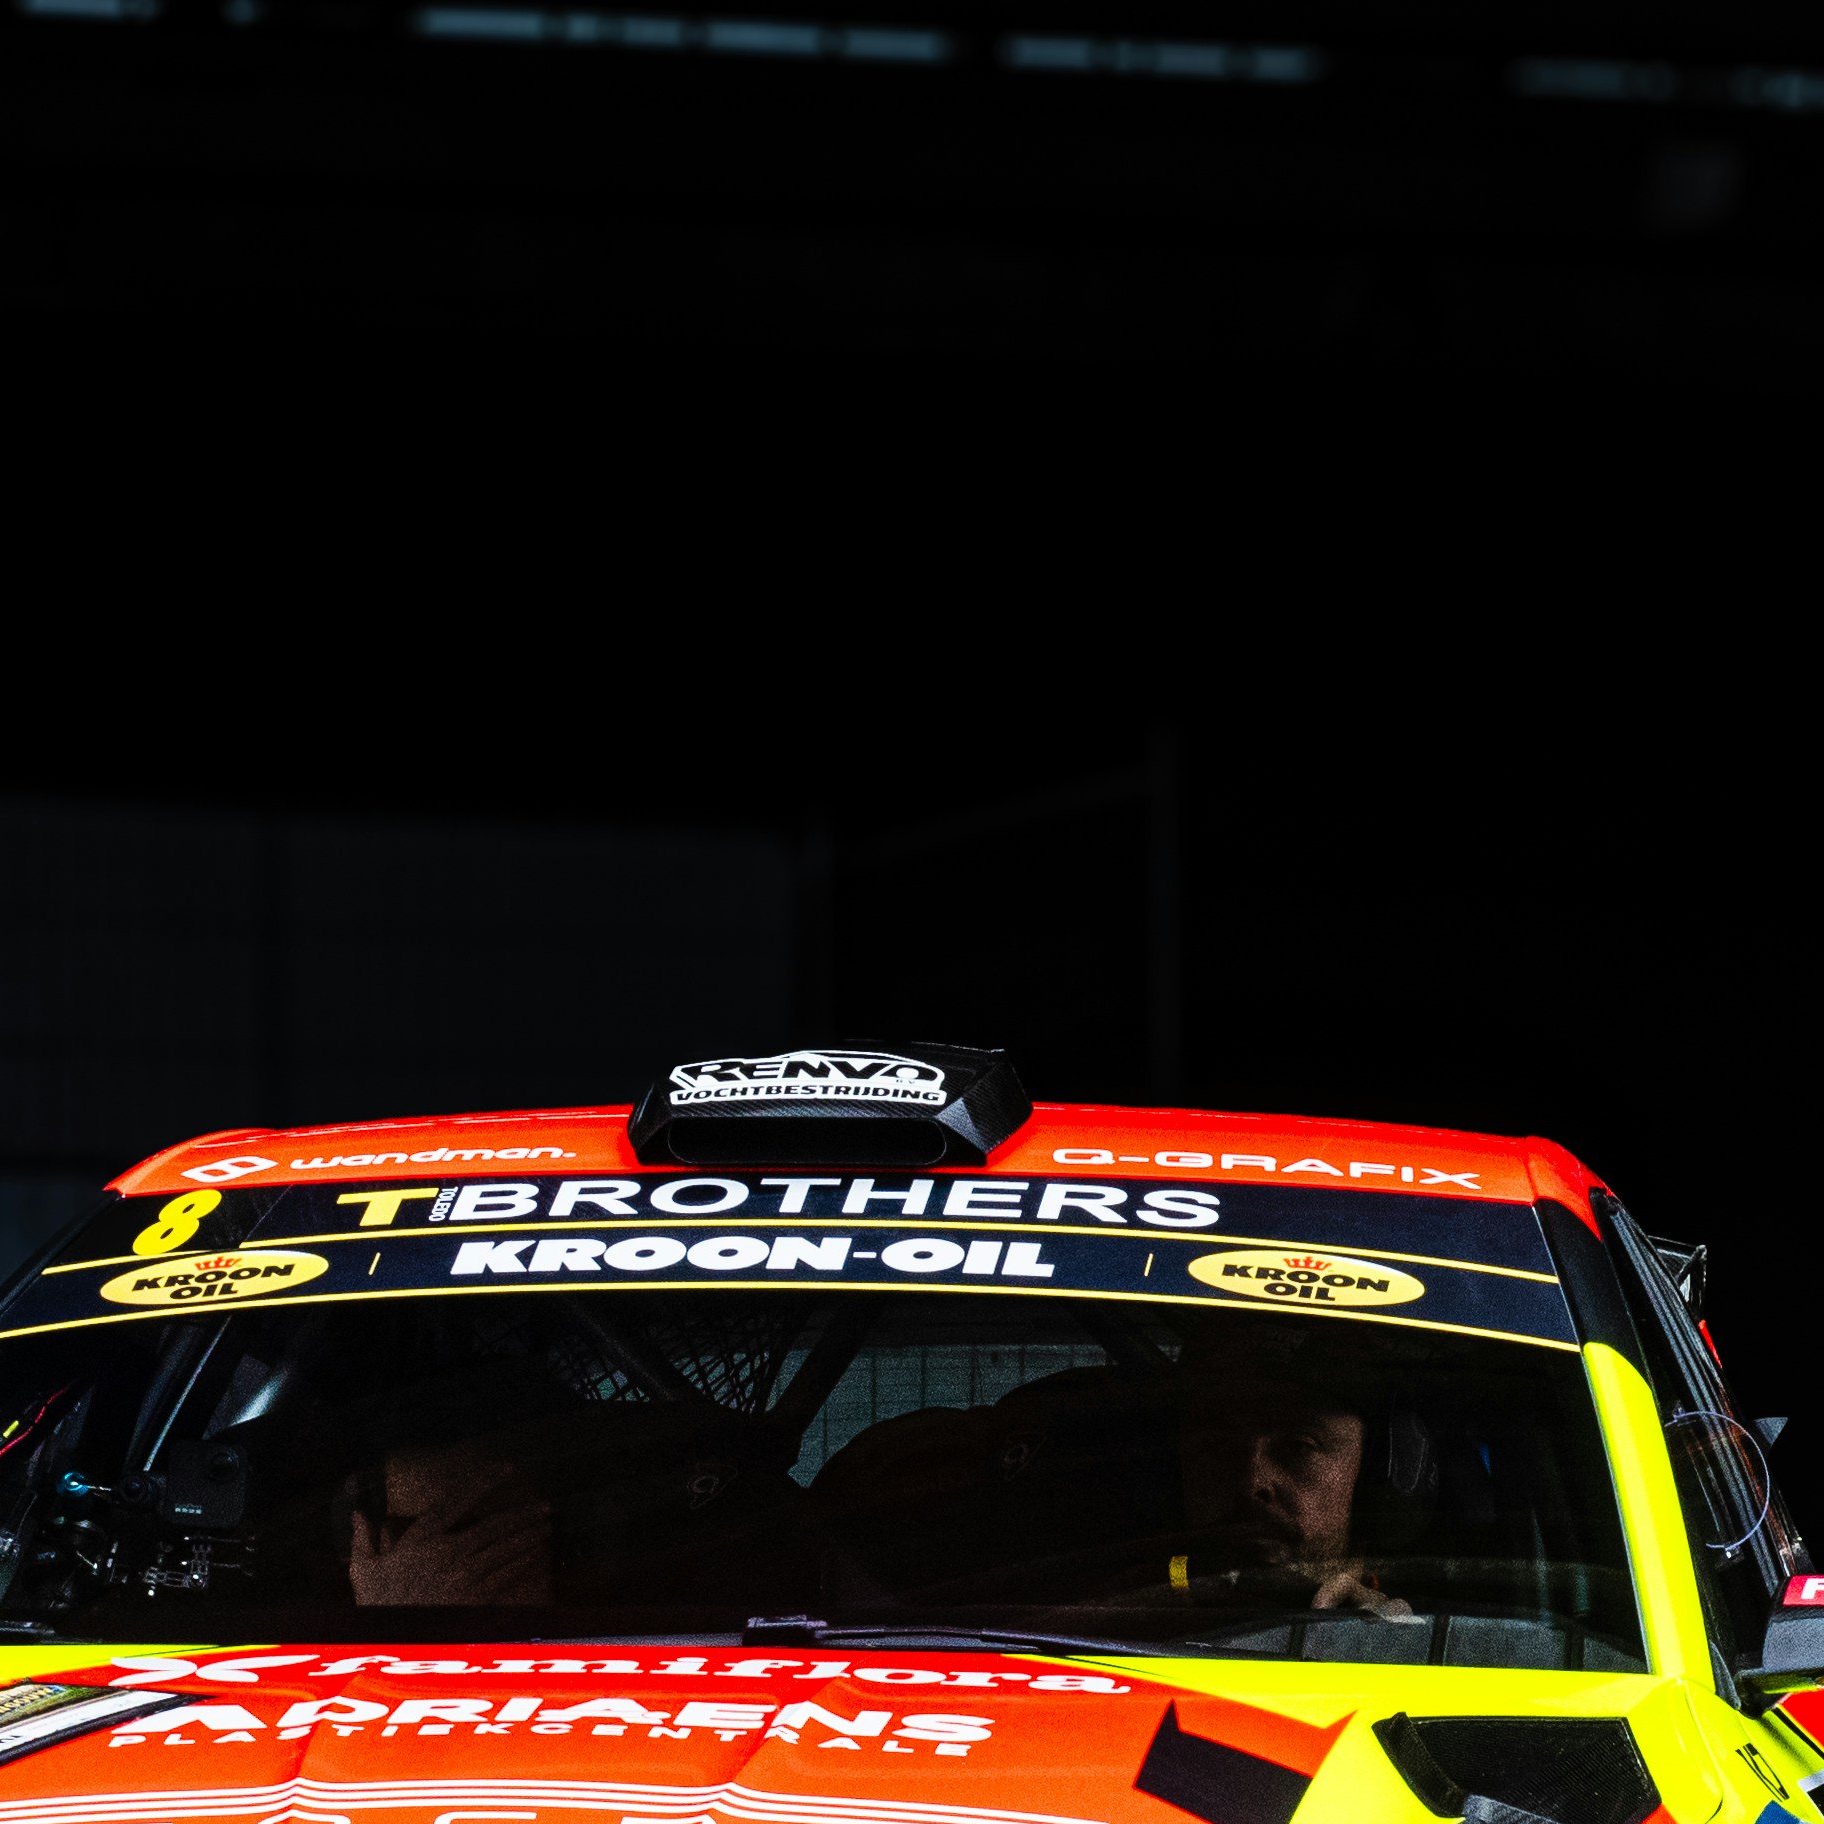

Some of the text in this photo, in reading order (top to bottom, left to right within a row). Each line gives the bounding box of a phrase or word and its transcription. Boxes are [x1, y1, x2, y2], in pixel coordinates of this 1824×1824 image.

[680, 1060, 938, 1083] RENVO
[676, 1084, 940, 1102] VOCHTBESTRIJDING
[1052, 1147, 1482, 1190] Q-GRAFIX
[428, 1186, 459, 1222] TOLEDO
[448, 1178, 1221, 1228] BROTHERS
[132, 1189, 223, 1256] 8
[450, 1235, 1055, 1278] KROON-OIL
[131, 1262, 297, 1293] KROON
[168, 1280, 240, 1301] OIL
[1221, 1262, 1390, 1293] KROON
[1263, 1282, 1337, 1302] OIL
[308, 1654, 1132, 1694] famiflora
[113, 1694, 995, 1745] ADRIAENS
[108, 1721, 973, 1757] PLASTIEKCENTRALE
